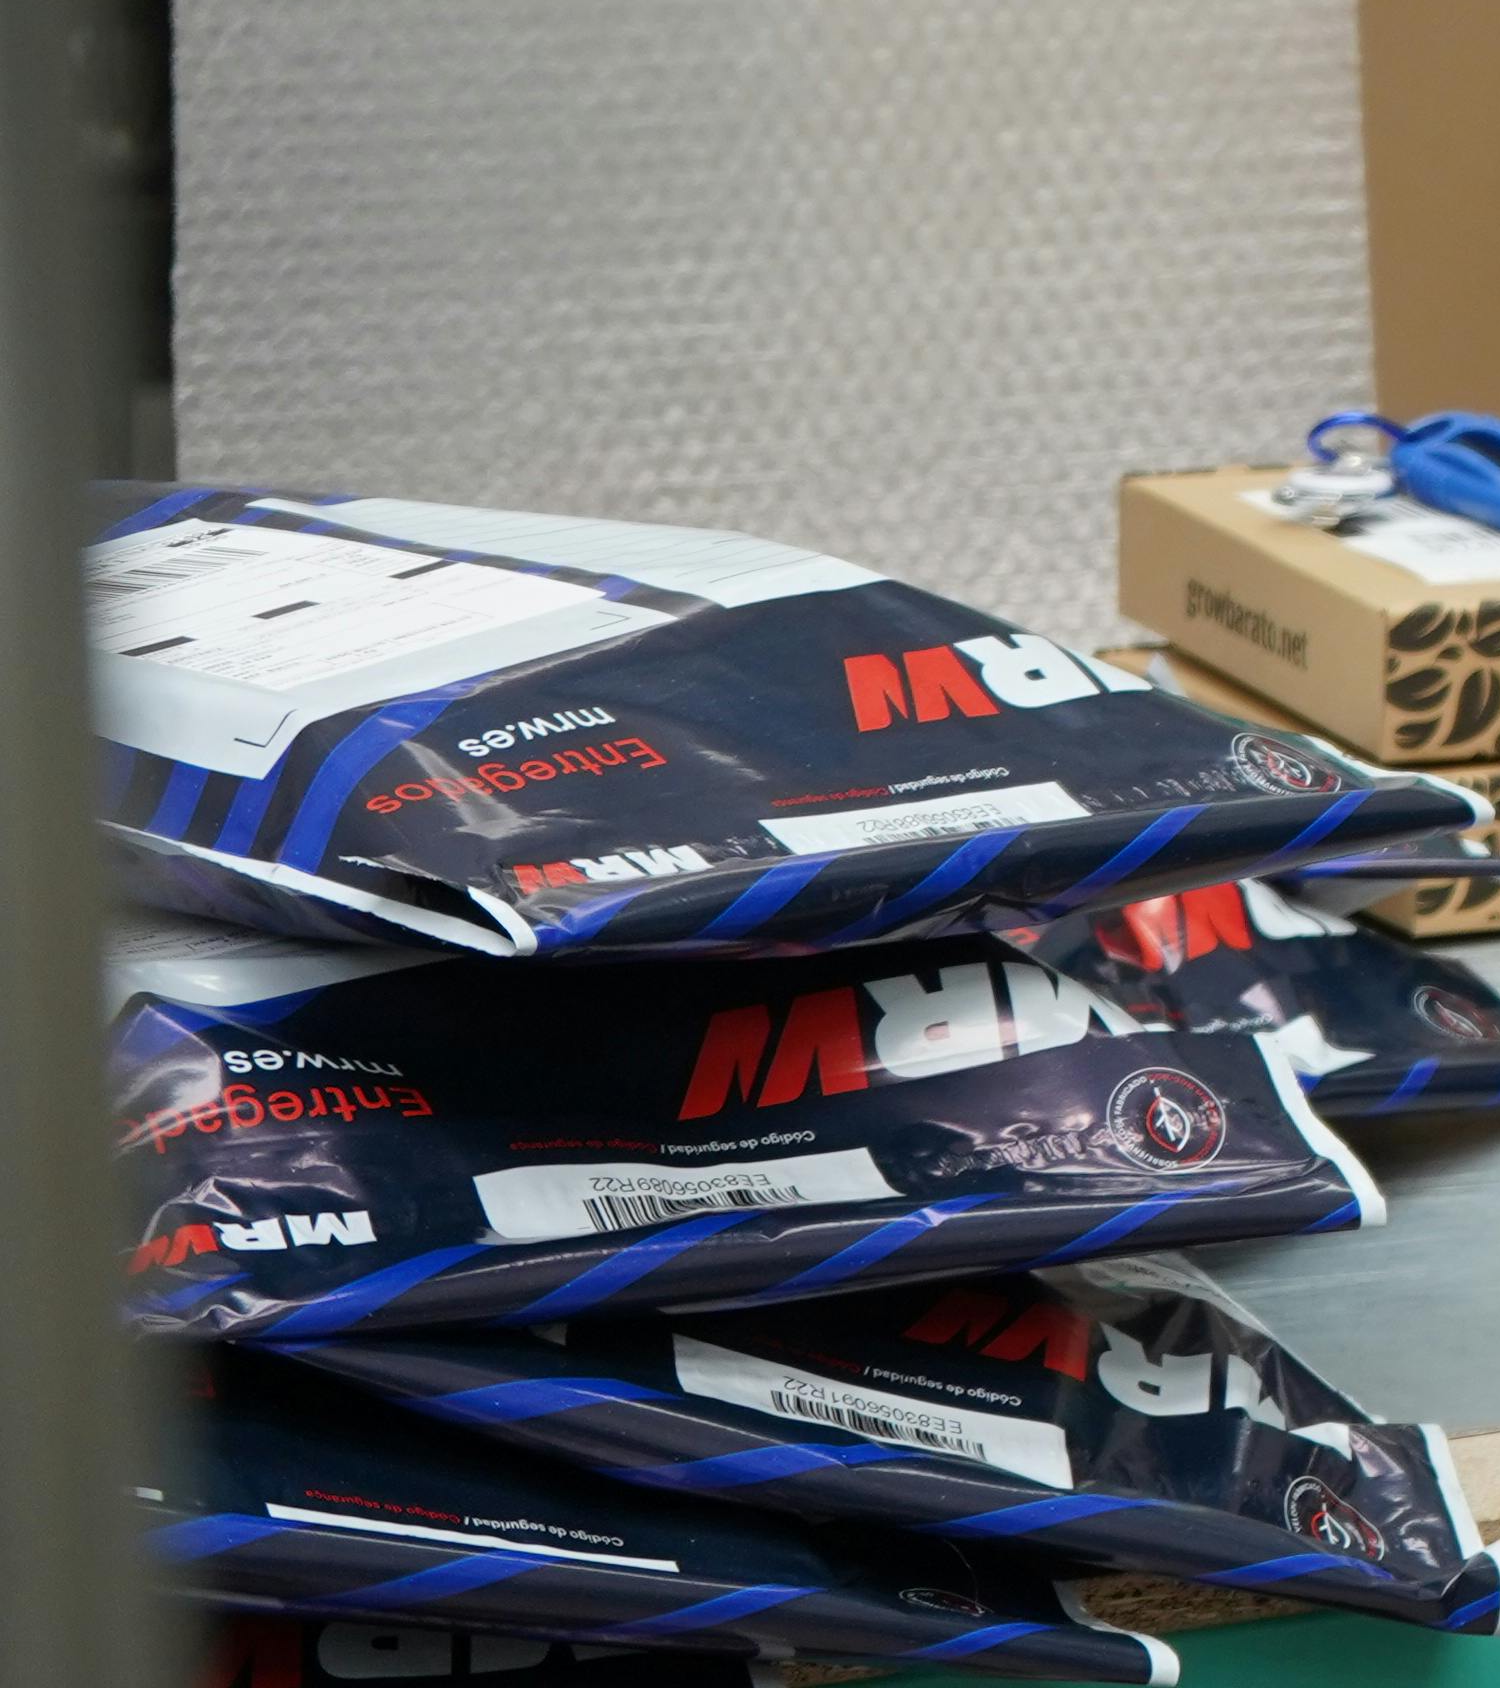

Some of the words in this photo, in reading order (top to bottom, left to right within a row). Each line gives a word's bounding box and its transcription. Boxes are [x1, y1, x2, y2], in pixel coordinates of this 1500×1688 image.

[1187, 578, 1308, 671] growbarato.net
[458, 706, 616, 759] mrw.es
[365, 737, 668, 817] Entregados
[511, 844, 714, 894] MRW
[222, 1048, 403, 1077] mrw.es
[667, 1139, 737, 1156] seguridad
[739, 1138, 758, 1152] de
[760, 1129, 815, 1147] Código
[588, 1174, 769, 1197] EE83056089R22
[127, 1210, 378, 1275] MRW
[873, 1367, 944, 1392] seguridad
[946, 1383, 965, 1397] de
[782, 1376, 962, 1434] EE83056091R22
[967, 1388, 1022, 1406] Código
[473, 1515, 545, 1535] seguridad
[548, 1525, 567, 1539] de
[570, 1529, 624, 1547] Código
